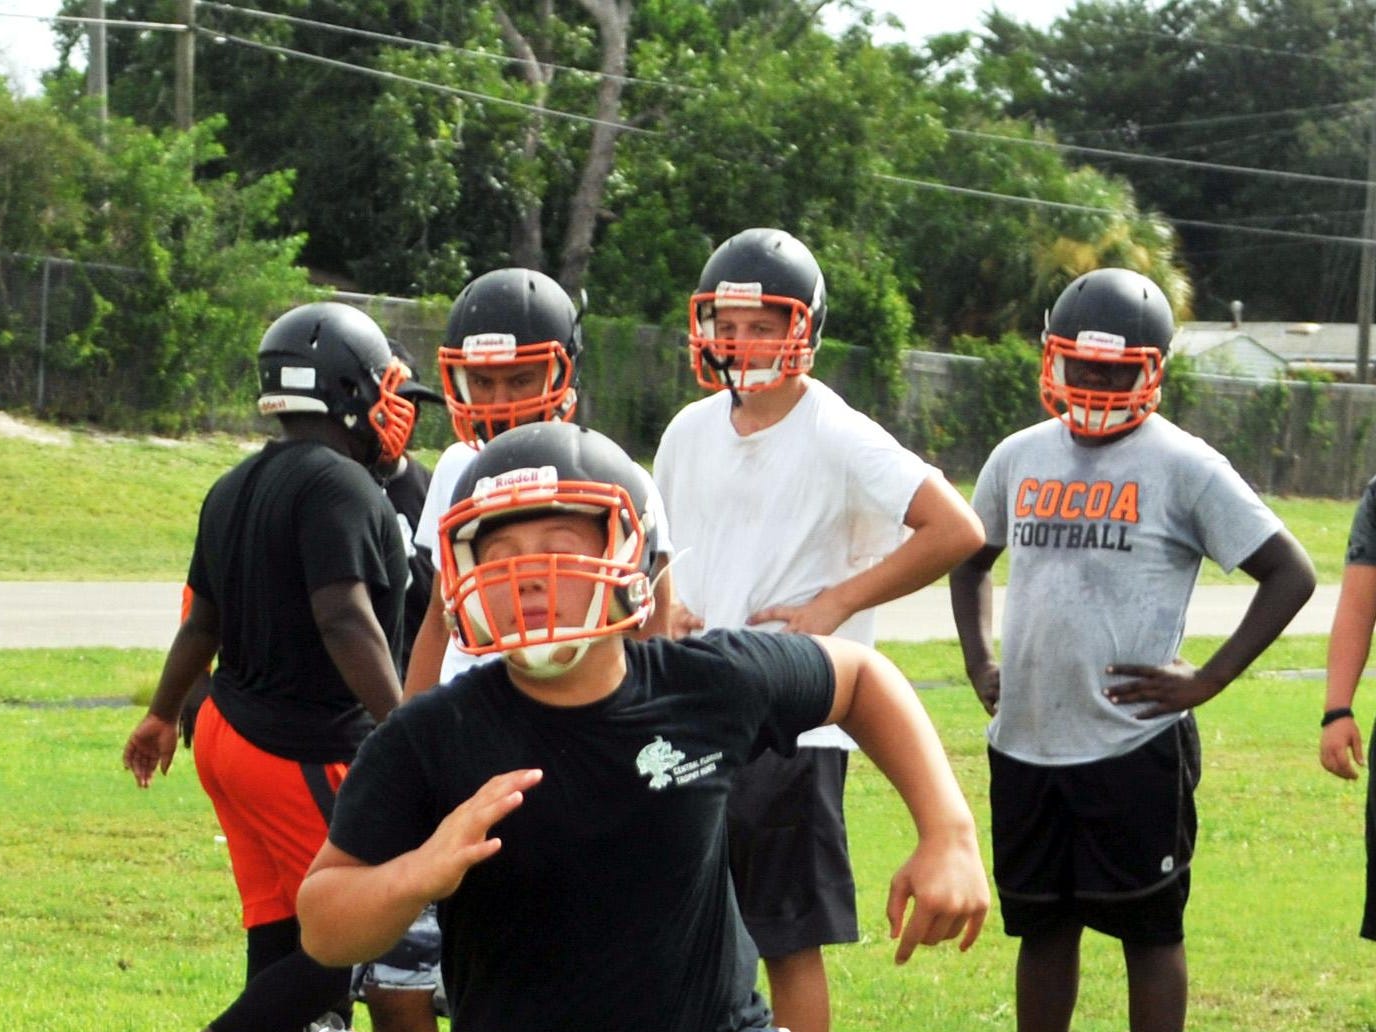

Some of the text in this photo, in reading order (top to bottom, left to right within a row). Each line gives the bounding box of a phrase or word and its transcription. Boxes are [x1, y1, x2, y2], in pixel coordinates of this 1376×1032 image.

[495, 471, 539, 489] Riddell
[1014, 477, 1141, 524] COCOA
[1012, 521, 1133, 553] FOOTBALL
